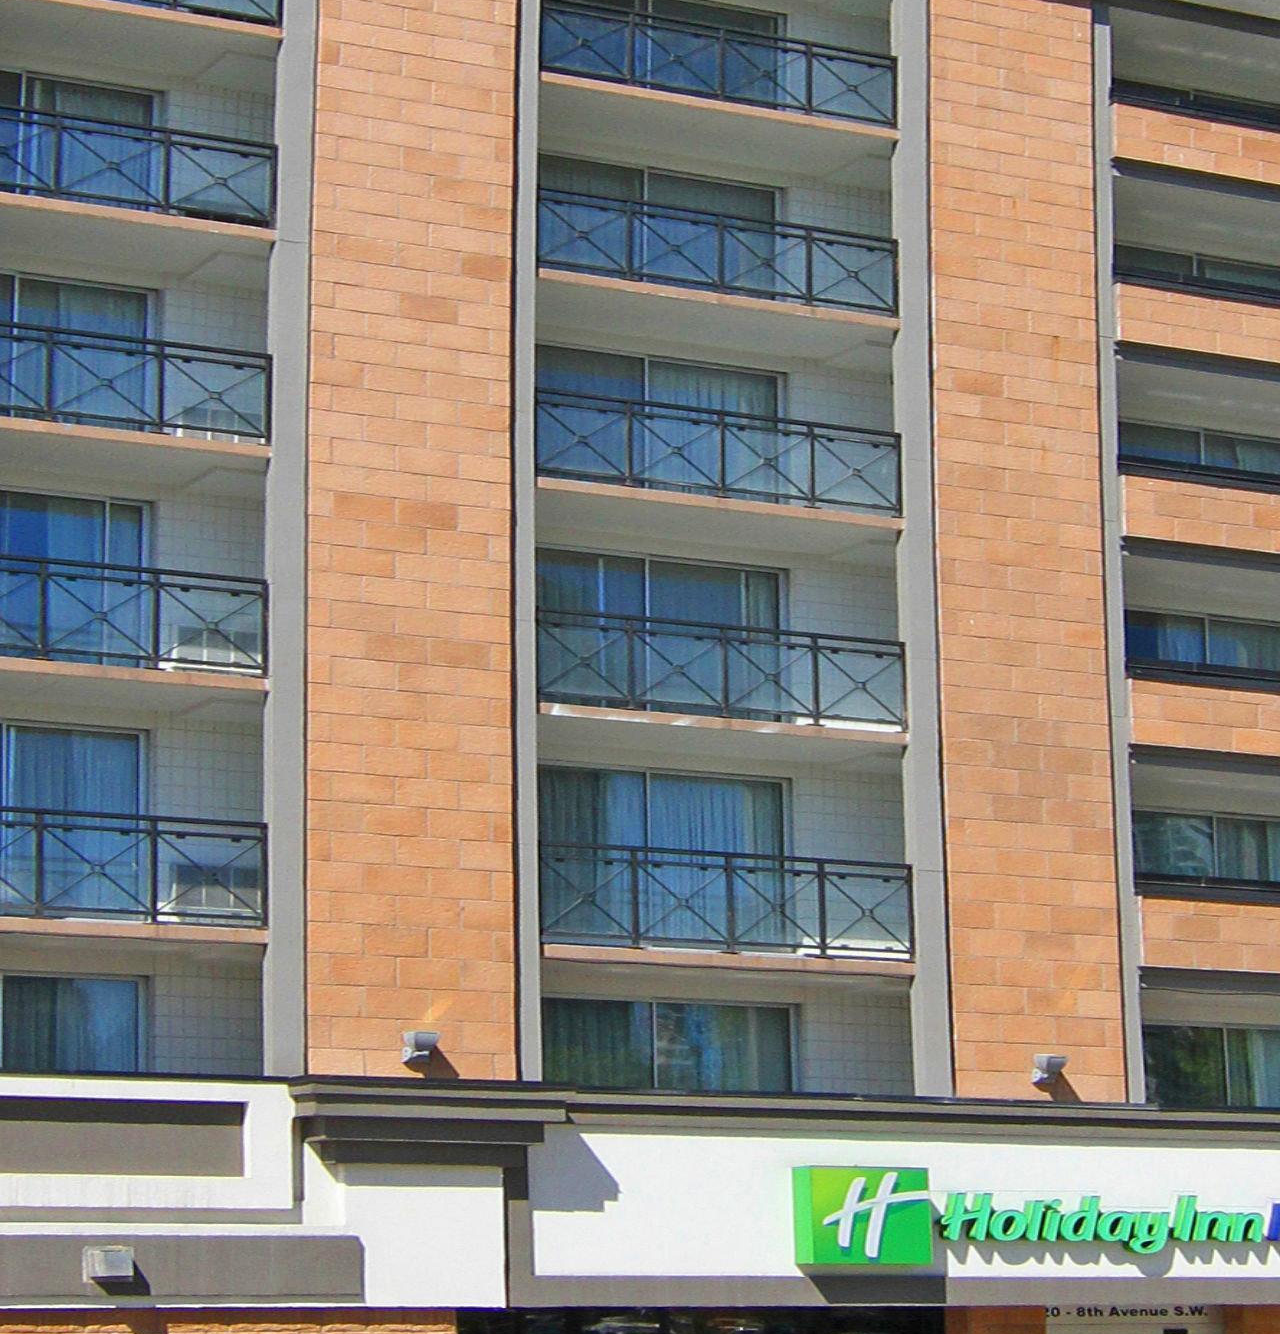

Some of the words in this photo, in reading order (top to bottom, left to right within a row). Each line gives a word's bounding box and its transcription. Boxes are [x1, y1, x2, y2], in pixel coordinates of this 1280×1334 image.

[941, 1193, 1169, 1254] Holiday
[1172, 1195, 1267, 1242] Inn
[1076, 1306, 1103, 1317] 8th
[1109, 1306, 1168, 1317] Avenue
[1173, 1305, 1208, 1316] S.W.
